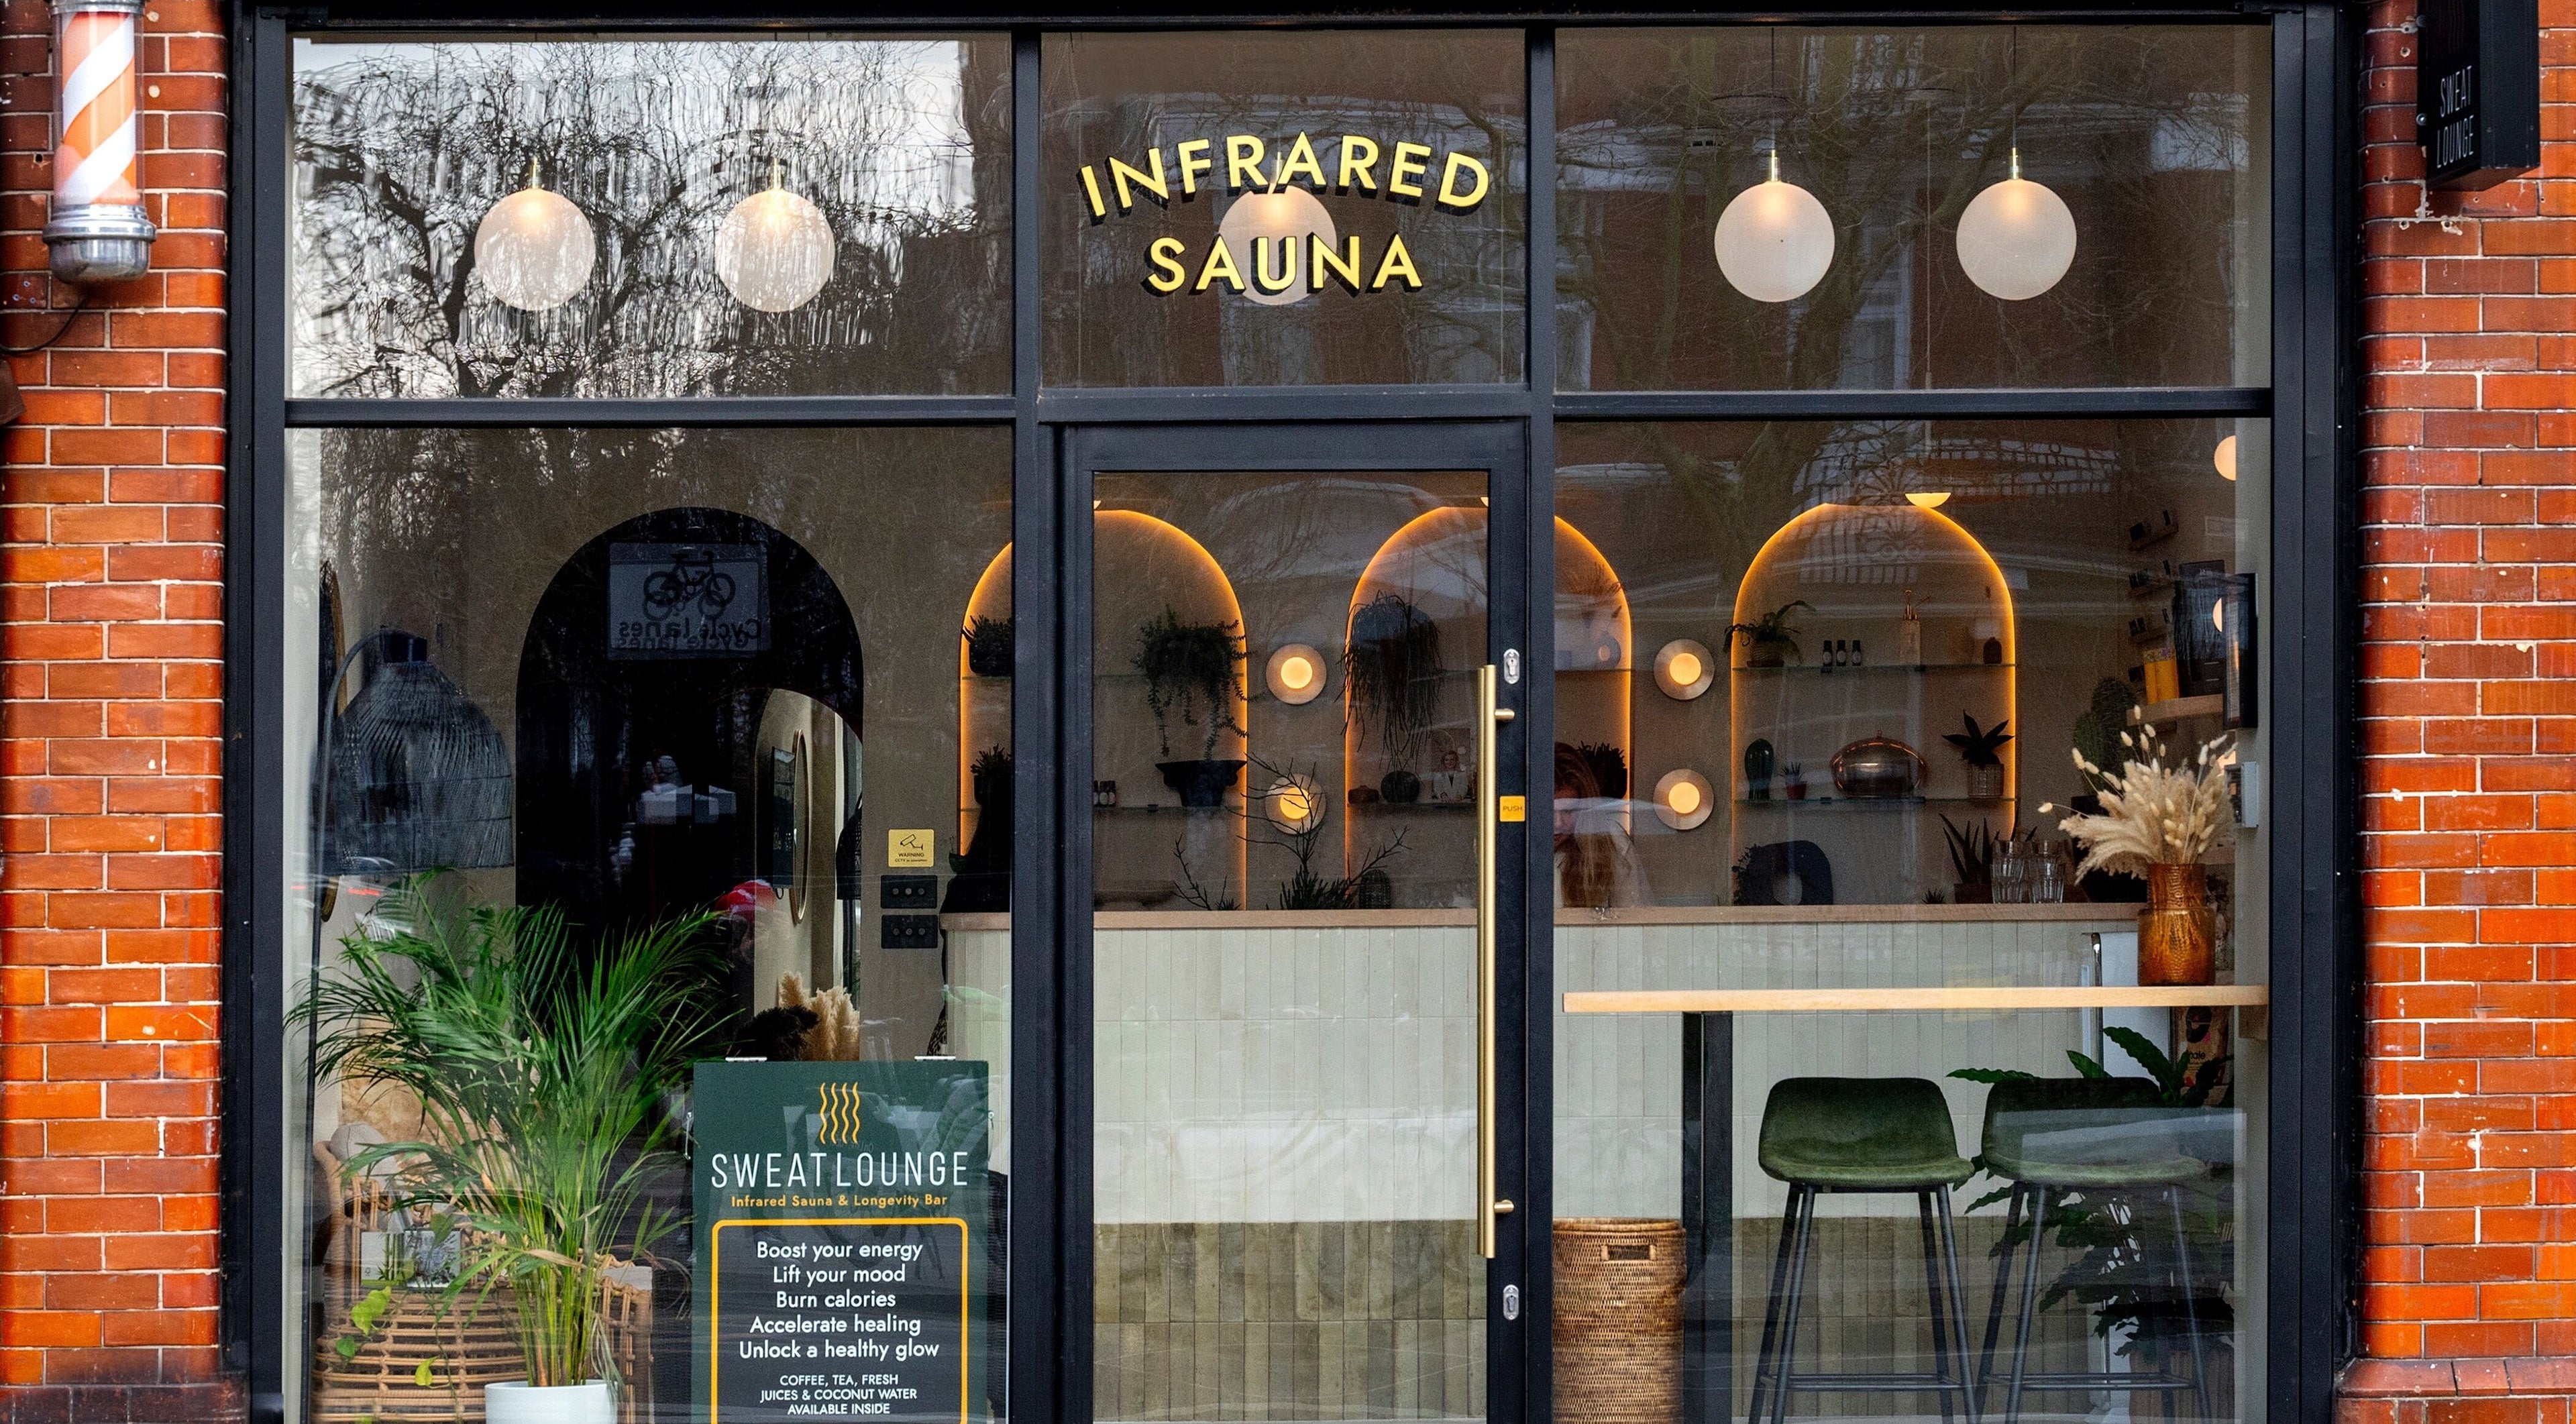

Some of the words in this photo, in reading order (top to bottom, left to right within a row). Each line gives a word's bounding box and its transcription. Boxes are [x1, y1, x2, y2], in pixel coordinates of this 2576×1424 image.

[2440, 65, 2472, 117] SWEAT
[2436, 115, 2474, 168] LOUNGE
[1079, 131, 1489, 219] INFRARED
[1146, 233, 1424, 294] SAUNA
[731, 1195, 786, 1207] Infrared
[792, 1195, 833, 1207] Sauna
[839, 1196, 847, 1205] &
[854, 1194, 919, 1208] Longevity
[925, 1193, 948, 1205] Bar
[758, 1242, 807, 1258] Boost
[812, 1246, 853, 1262] your
[859, 1245, 922, 1261] energy
[774, 1264, 800, 1282] Lift
[806, 1270, 847, 1287] your
[854, 1264, 905, 1282] mood
[777, 1291, 816, 1307] Burn
[825, 1289, 896, 1307] calories
[750, 1315, 847, 1333] Accelerate
[855, 1313, 920, 1336] healing
[740, 1339, 800, 1358] Unlock
[807, 1346, 817, 1358] a
[825, 1339, 889, 1361] healthy
[896, 1338, 938, 1361] glow
[780, 1375, 828, 1386] COFFEE,
[833, 1375, 857, 1386] TEA,
[862, 1374, 898, 1384] FRESH
[760, 1390, 798, 1403] JUICES
[802, 1390, 810, 1400] &
[814, 1389, 875, 1400] COCONUT
[878, 1388, 916, 1399] WATER
[788, 1404, 847, 1415] AVAILABLE
[852, 1403, 890, 1414] INSIDE
